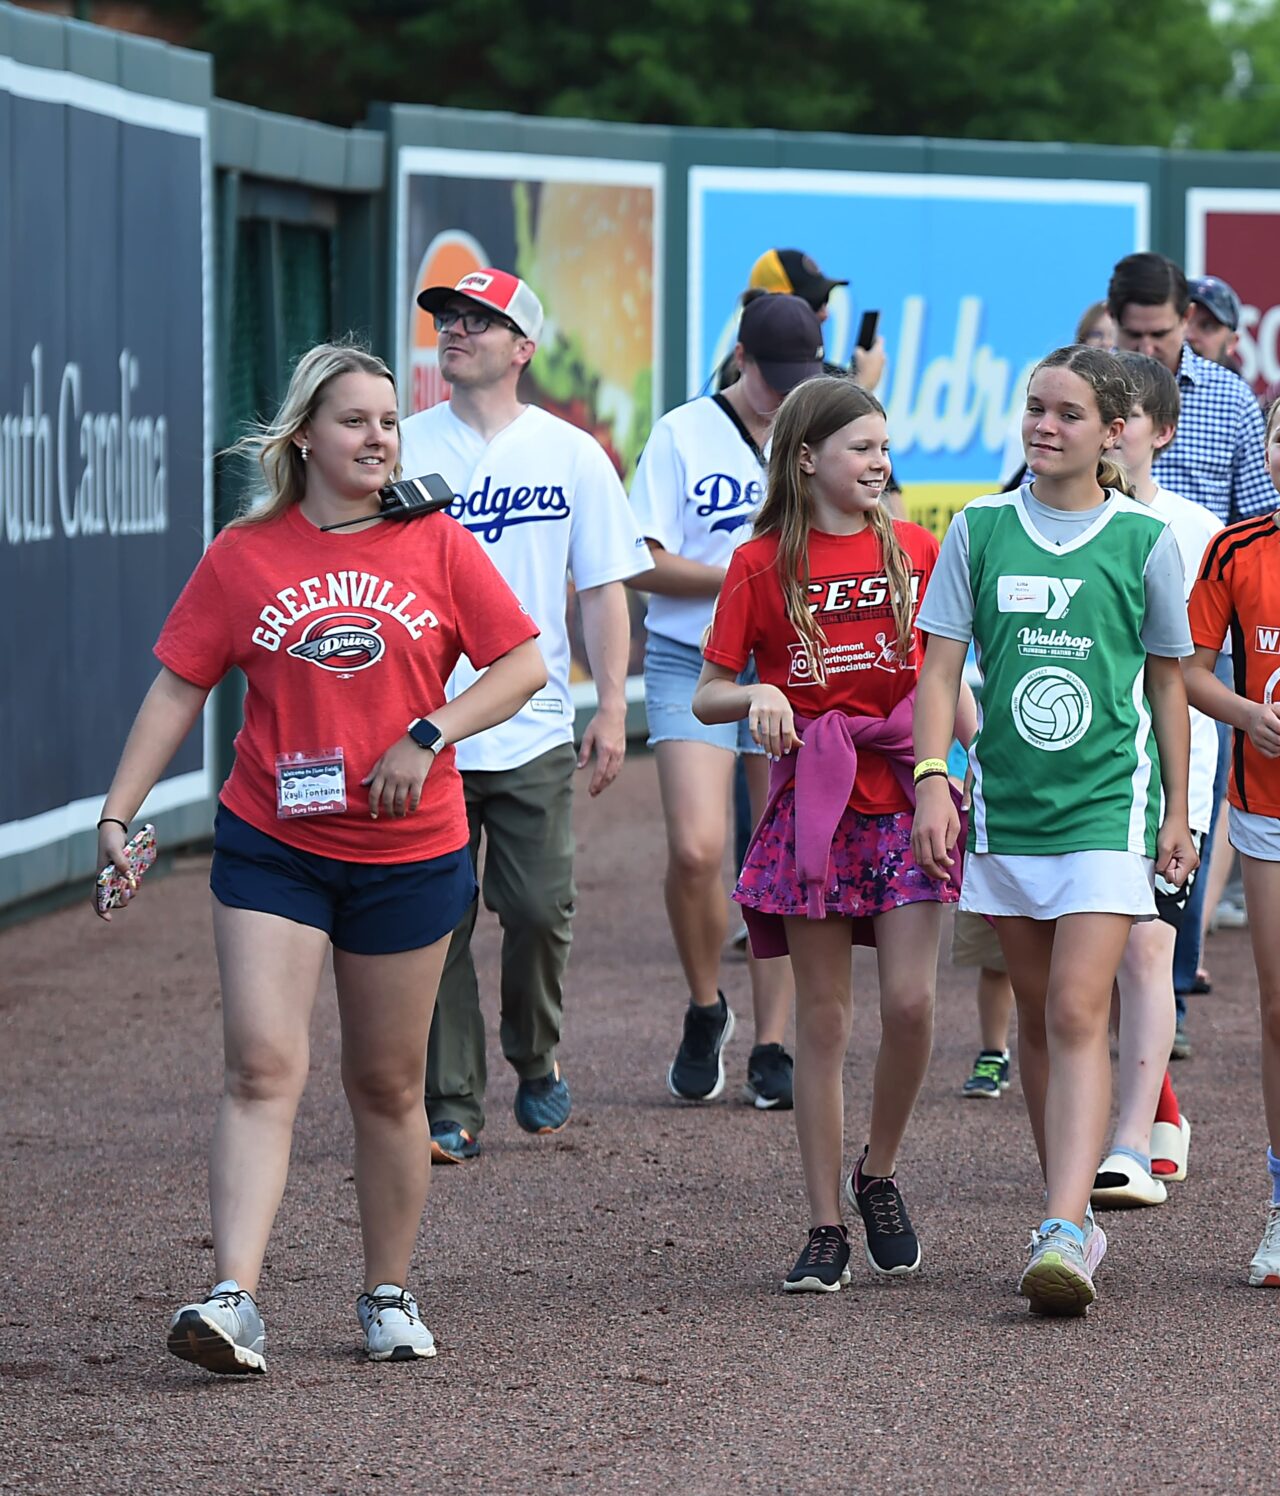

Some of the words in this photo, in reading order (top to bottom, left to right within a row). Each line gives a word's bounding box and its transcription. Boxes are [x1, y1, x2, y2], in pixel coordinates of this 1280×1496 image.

[58, 347, 167, 538] Carolina
[444, 476, 570, 543] odgers
[251, 570, 439, 652] GREENVILLE
[319, 633, 377, 656] Drive
[1017, 627, 1095, 652] Waldrop
[823, 652, 876, 664] orthopaedic
[1027, 668, 1048, 681] RESPECT
